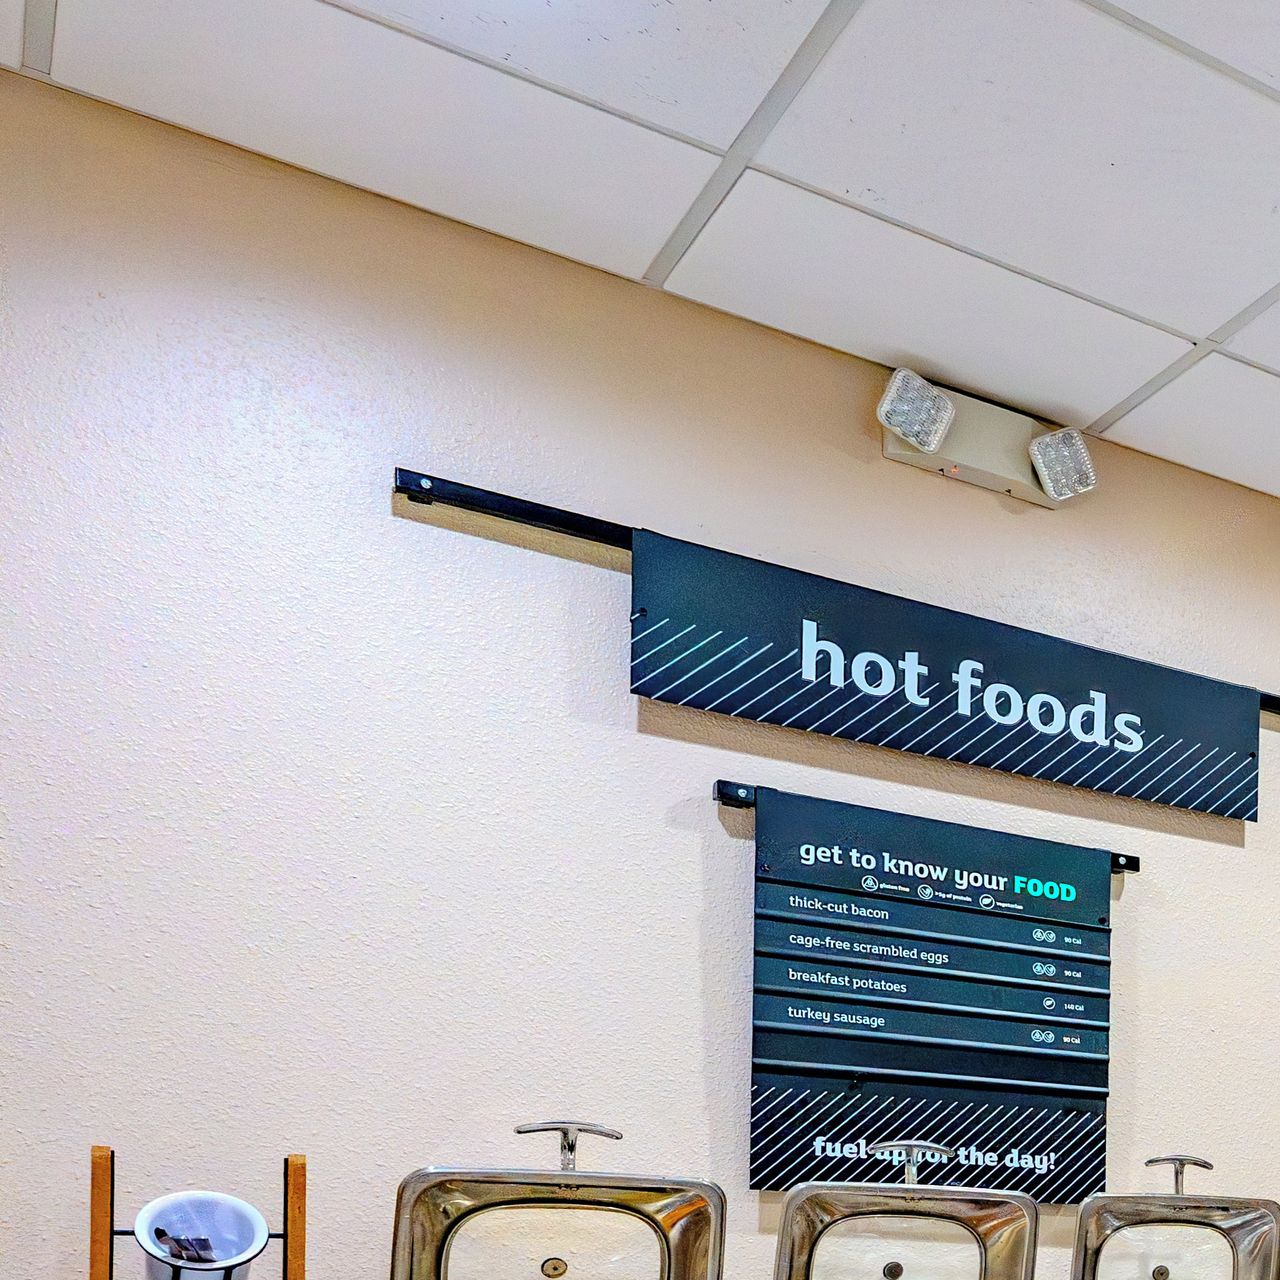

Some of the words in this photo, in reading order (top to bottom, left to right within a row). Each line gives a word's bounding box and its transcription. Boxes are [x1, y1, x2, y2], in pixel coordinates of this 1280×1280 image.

[800, 619, 931, 709] hot
[951, 659, 1145, 753] foods
[800, 845, 842, 864] get
[849, 849, 876, 869] to
[883, 852, 948, 881] know
[955, 870, 1008, 890] your
[1015, 876, 1076, 901] FOOD
[789, 896, 848, 916] thick-cut
[851, 900, 889, 920] bacon
[789, 932, 850, 952] cage-free
[852, 938, 918, 960] scrambled
[920, 949, 949, 965] eggs
[788, 968, 850, 988] breakfast
[852, 974, 907, 993] potatoes
[787, 1006, 831, 1023] turkey
[834, 1012, 885, 1028] sausage
[813, 1136, 867, 1158] fuel
[957, 1146, 999, 1166] the
[1004, 1149, 1056, 1174] day!
